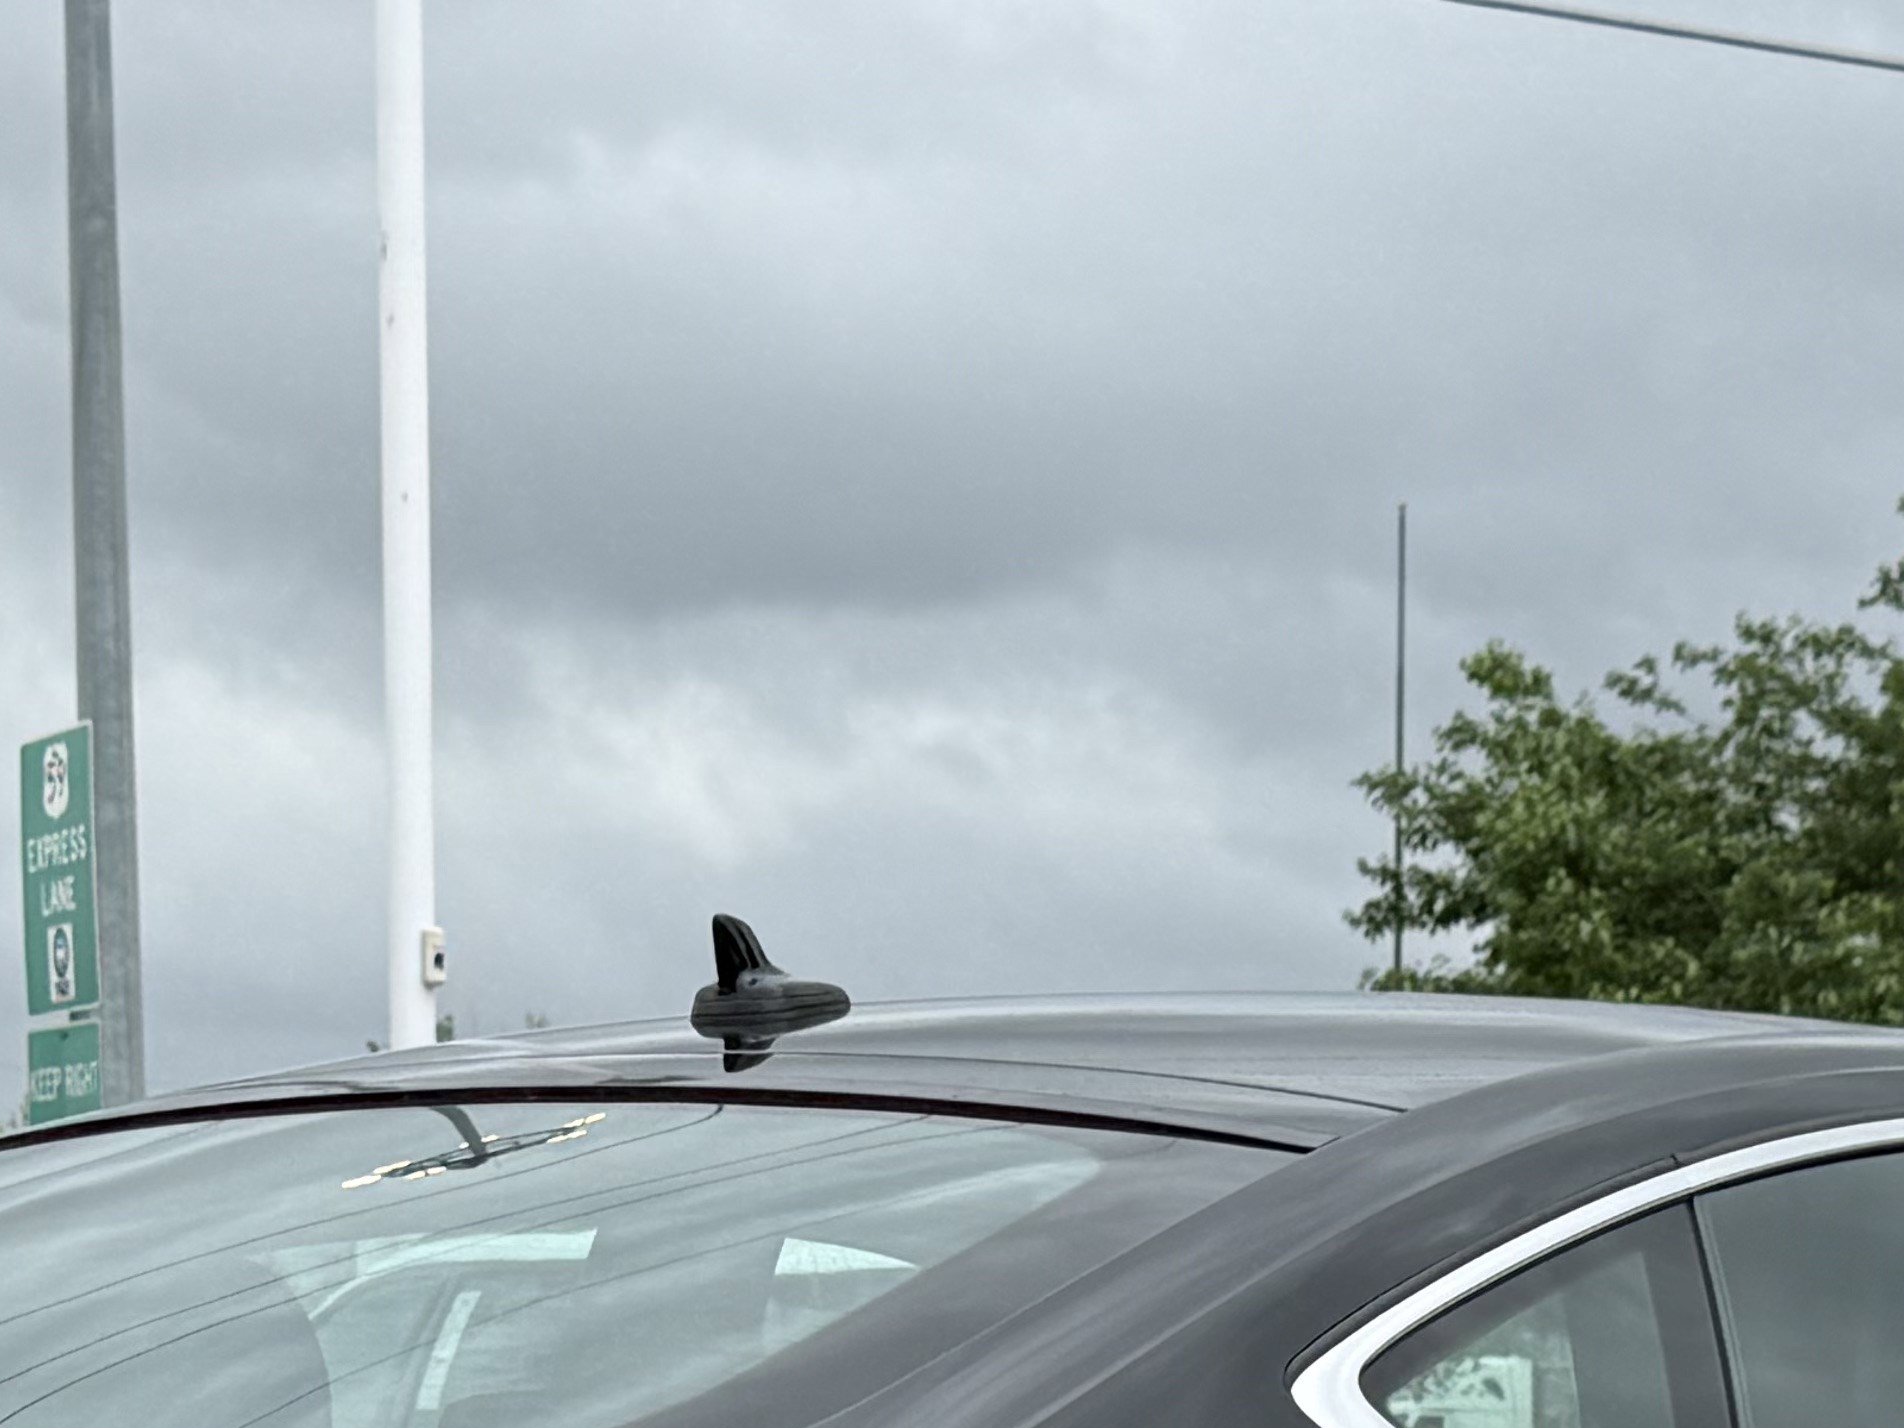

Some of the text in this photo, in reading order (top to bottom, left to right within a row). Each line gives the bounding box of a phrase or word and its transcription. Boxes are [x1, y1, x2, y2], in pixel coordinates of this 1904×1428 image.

[27, 824, 87, 874] EXPRESS
[41, 875, 77, 917] LANE
[30, 1060, 98, 1102] KEEP RIGHT
